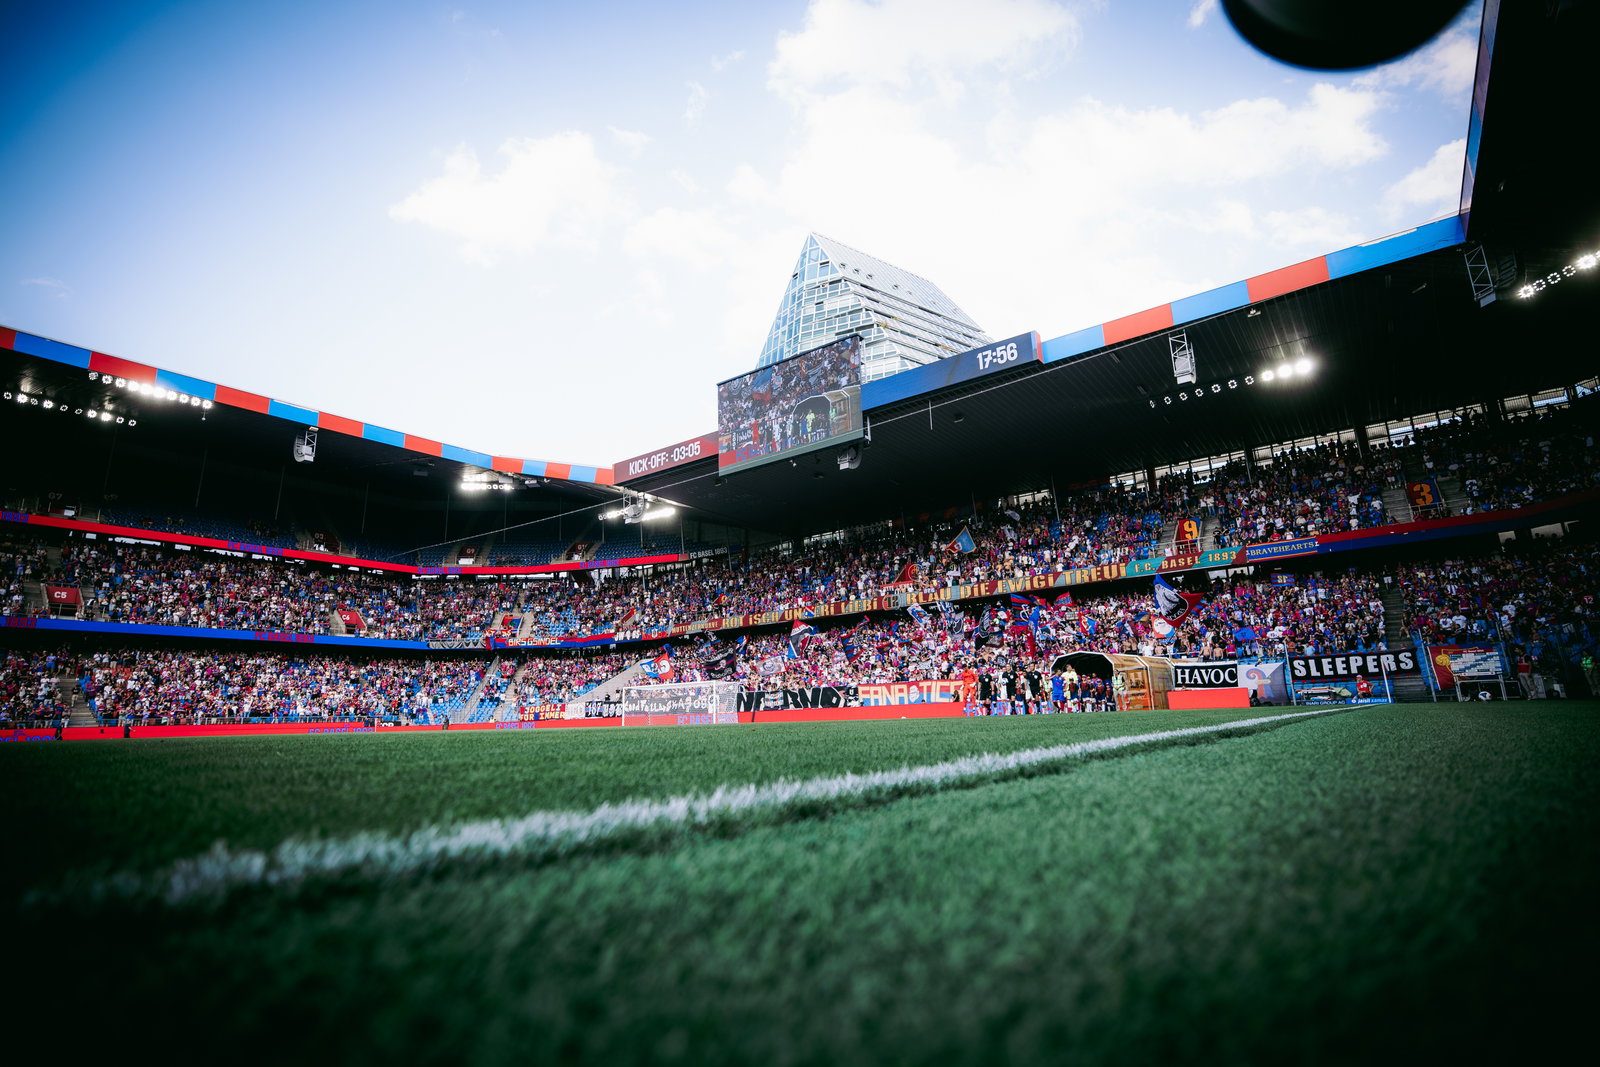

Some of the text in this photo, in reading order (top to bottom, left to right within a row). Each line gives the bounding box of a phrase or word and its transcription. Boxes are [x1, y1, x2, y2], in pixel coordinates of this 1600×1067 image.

[976, 343, 1018, 370] 17:56
[629, 441, 701, 476] KICK-OFF: -03:05
[1413, 483, 1434, 505] 3
[1183, 520, 1198, 540] 9
[697, 550, 714, 558] BASEL
[1250, 541, 1315, 556] BRAVEHEARTS
[54, 591, 67, 599] C5
[722, 615, 744, 628] ROT
[906, 588, 952, 606] BLAU
[1134, 563, 1157, 574] F.C.
[1162, 556, 1201, 570] BASEL
[1208, 551, 1237, 562] 1893
[6, 616, 37, 628] 1893
[255, 631, 267, 641] FC
[267, 632, 293, 642] BASEL
[1293, 651, 1414, 677] SLEEPERS
[1176, 667, 1237, 685] HAVOC
[524, 704, 562, 714] JOGGELI
[539, 711, 565, 720] IMMER
